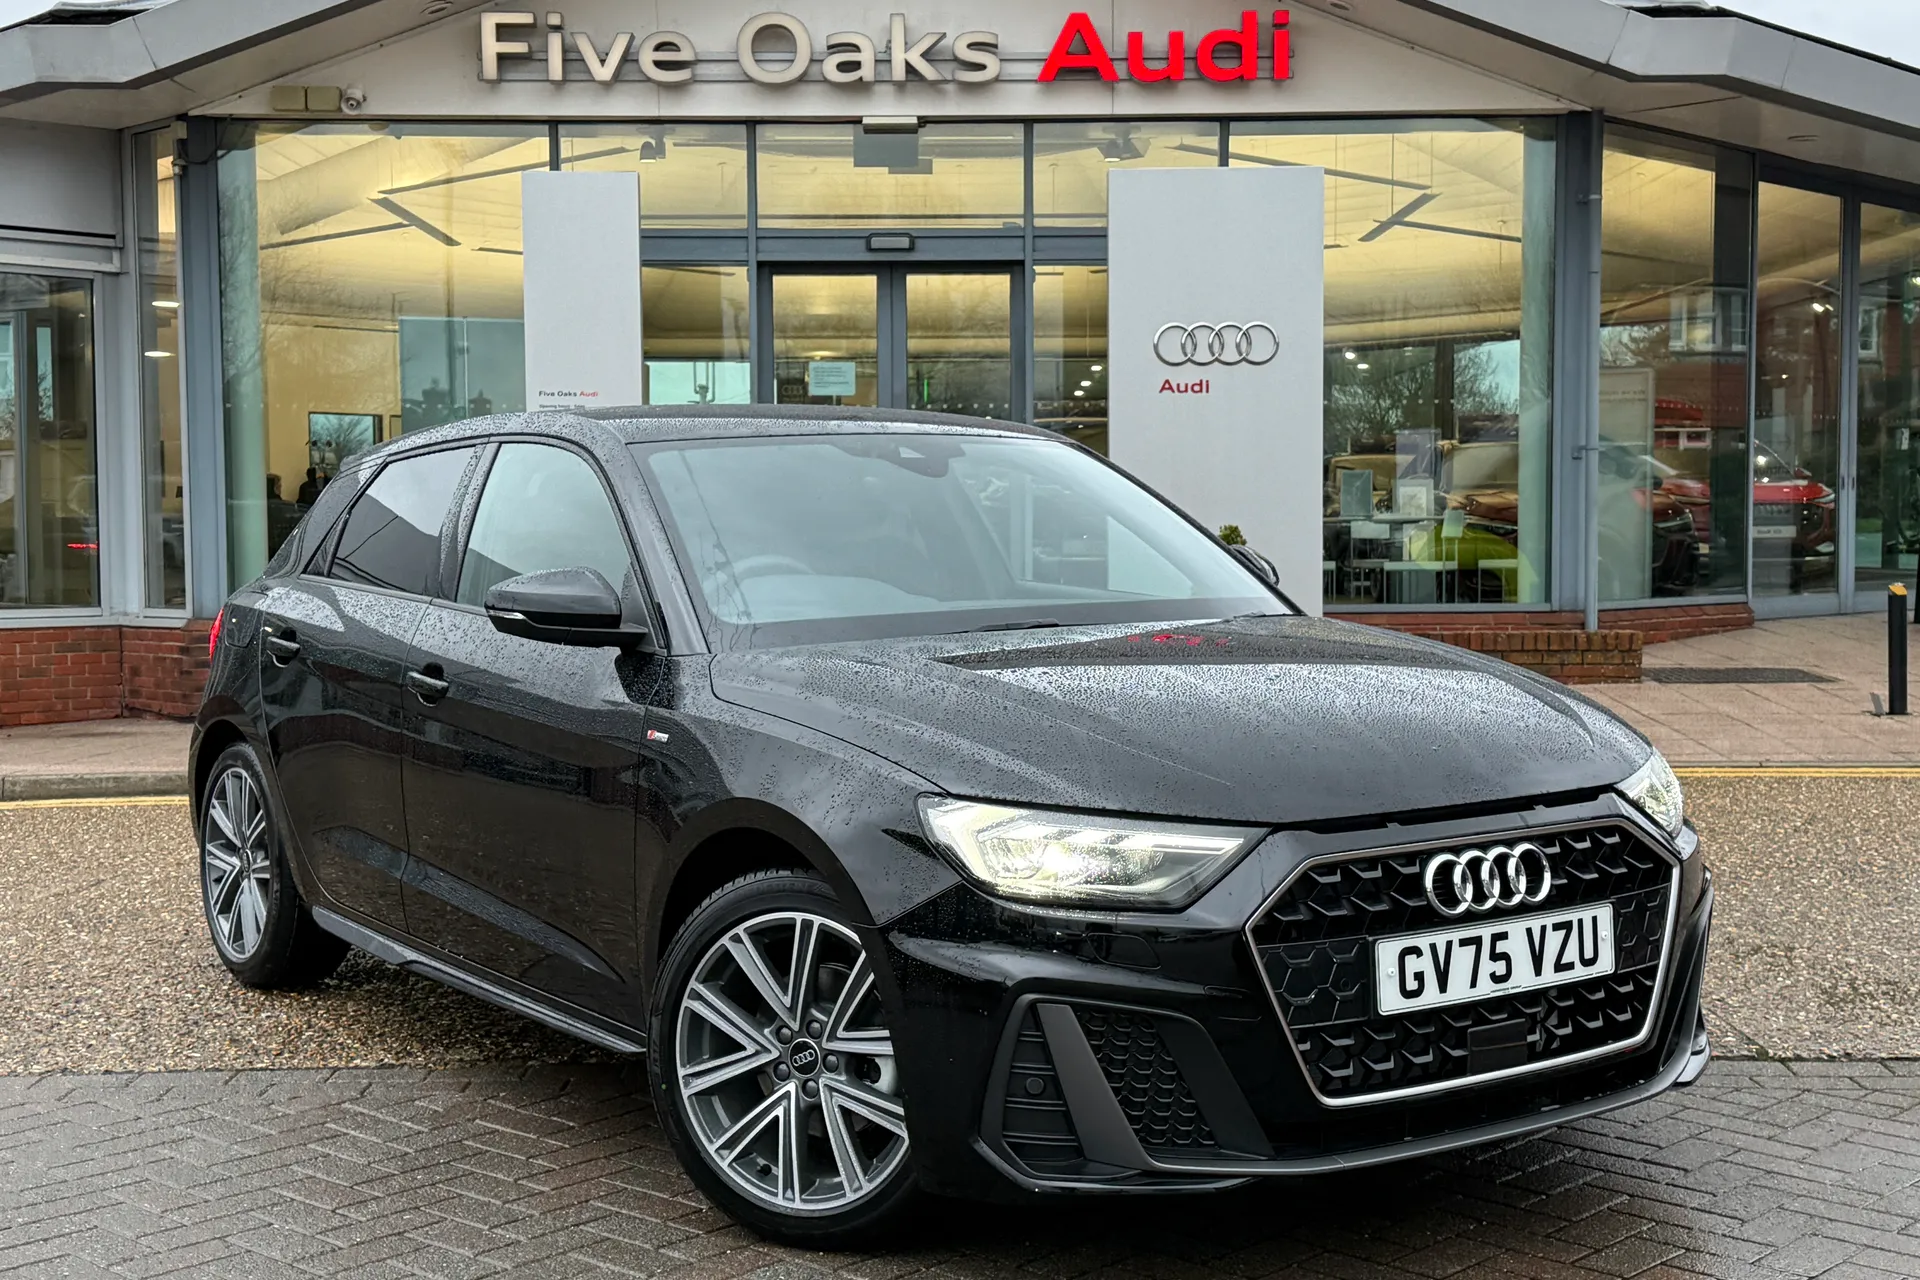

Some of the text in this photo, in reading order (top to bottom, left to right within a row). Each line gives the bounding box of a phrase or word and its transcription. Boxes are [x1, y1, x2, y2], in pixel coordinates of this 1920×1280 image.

[478, 9, 1293, 85] Five Oaks Audi
[1159, 379, 1210, 394] Audi
[1397, 915, 1599, 1000] GV75 VZU
